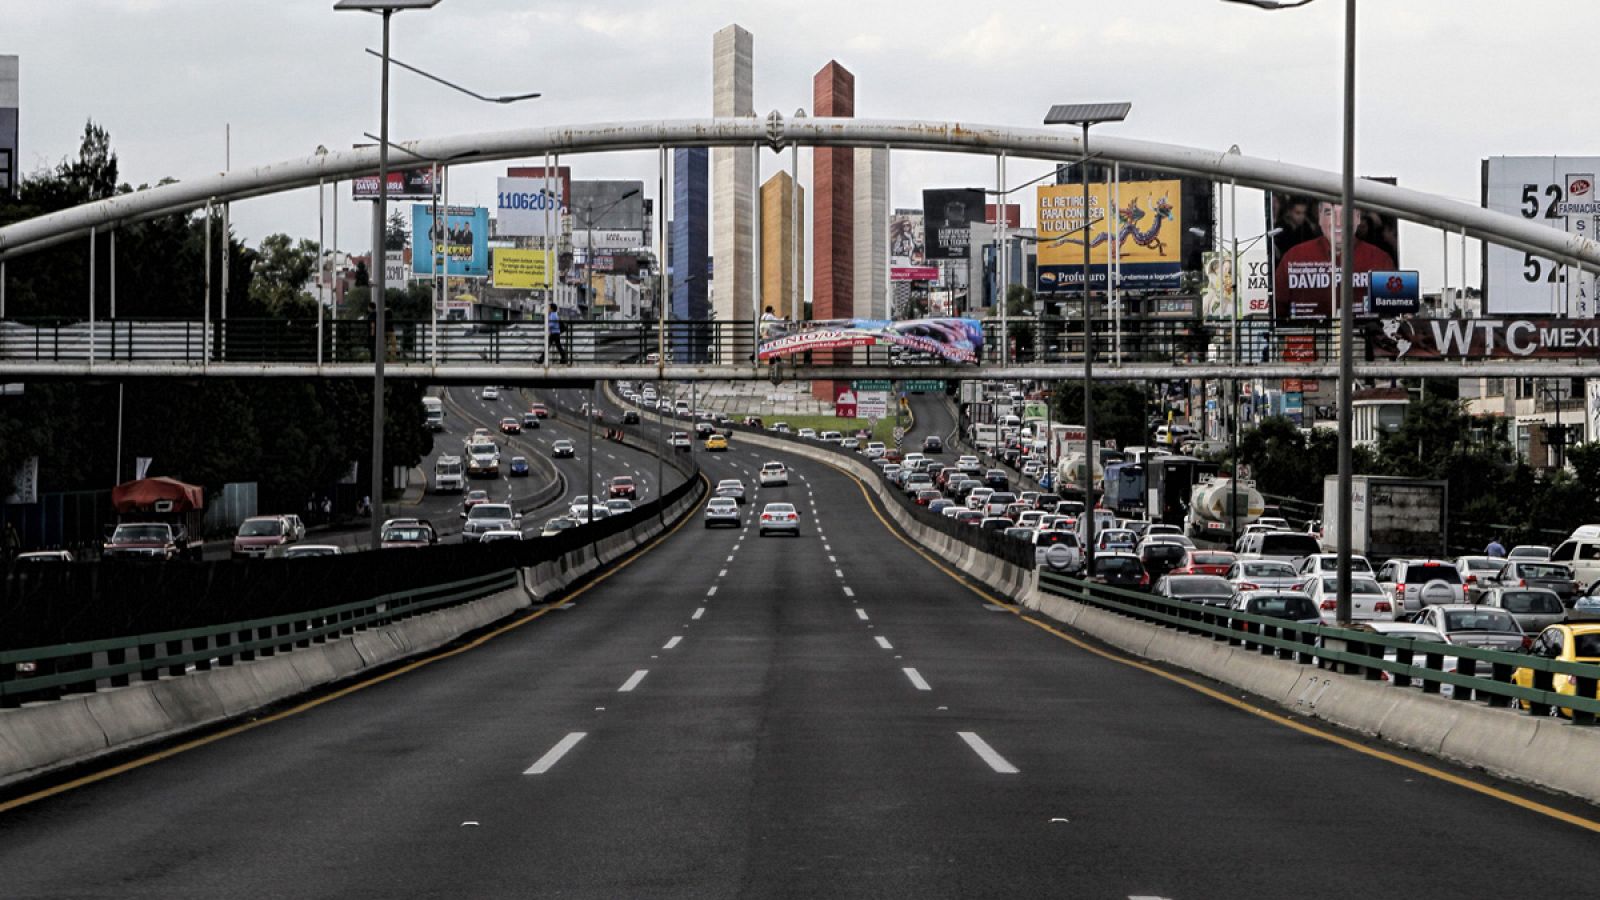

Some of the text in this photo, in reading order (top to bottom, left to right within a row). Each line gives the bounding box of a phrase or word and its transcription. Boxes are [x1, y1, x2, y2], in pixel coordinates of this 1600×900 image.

[356, 182, 378, 190] DAVID
[1042, 196, 1052, 207] EL
[1042, 207, 1105, 219] PARA CONCER
[1041, 221, 1053, 232] TU
[1058, 271, 1106, 282] Profuuro
[1288, 272, 1369, 289] DAVID PRR
[1375, 298, 1414, 306] Banamex
[1430, 320, 1599, 356] WTC MEXI
